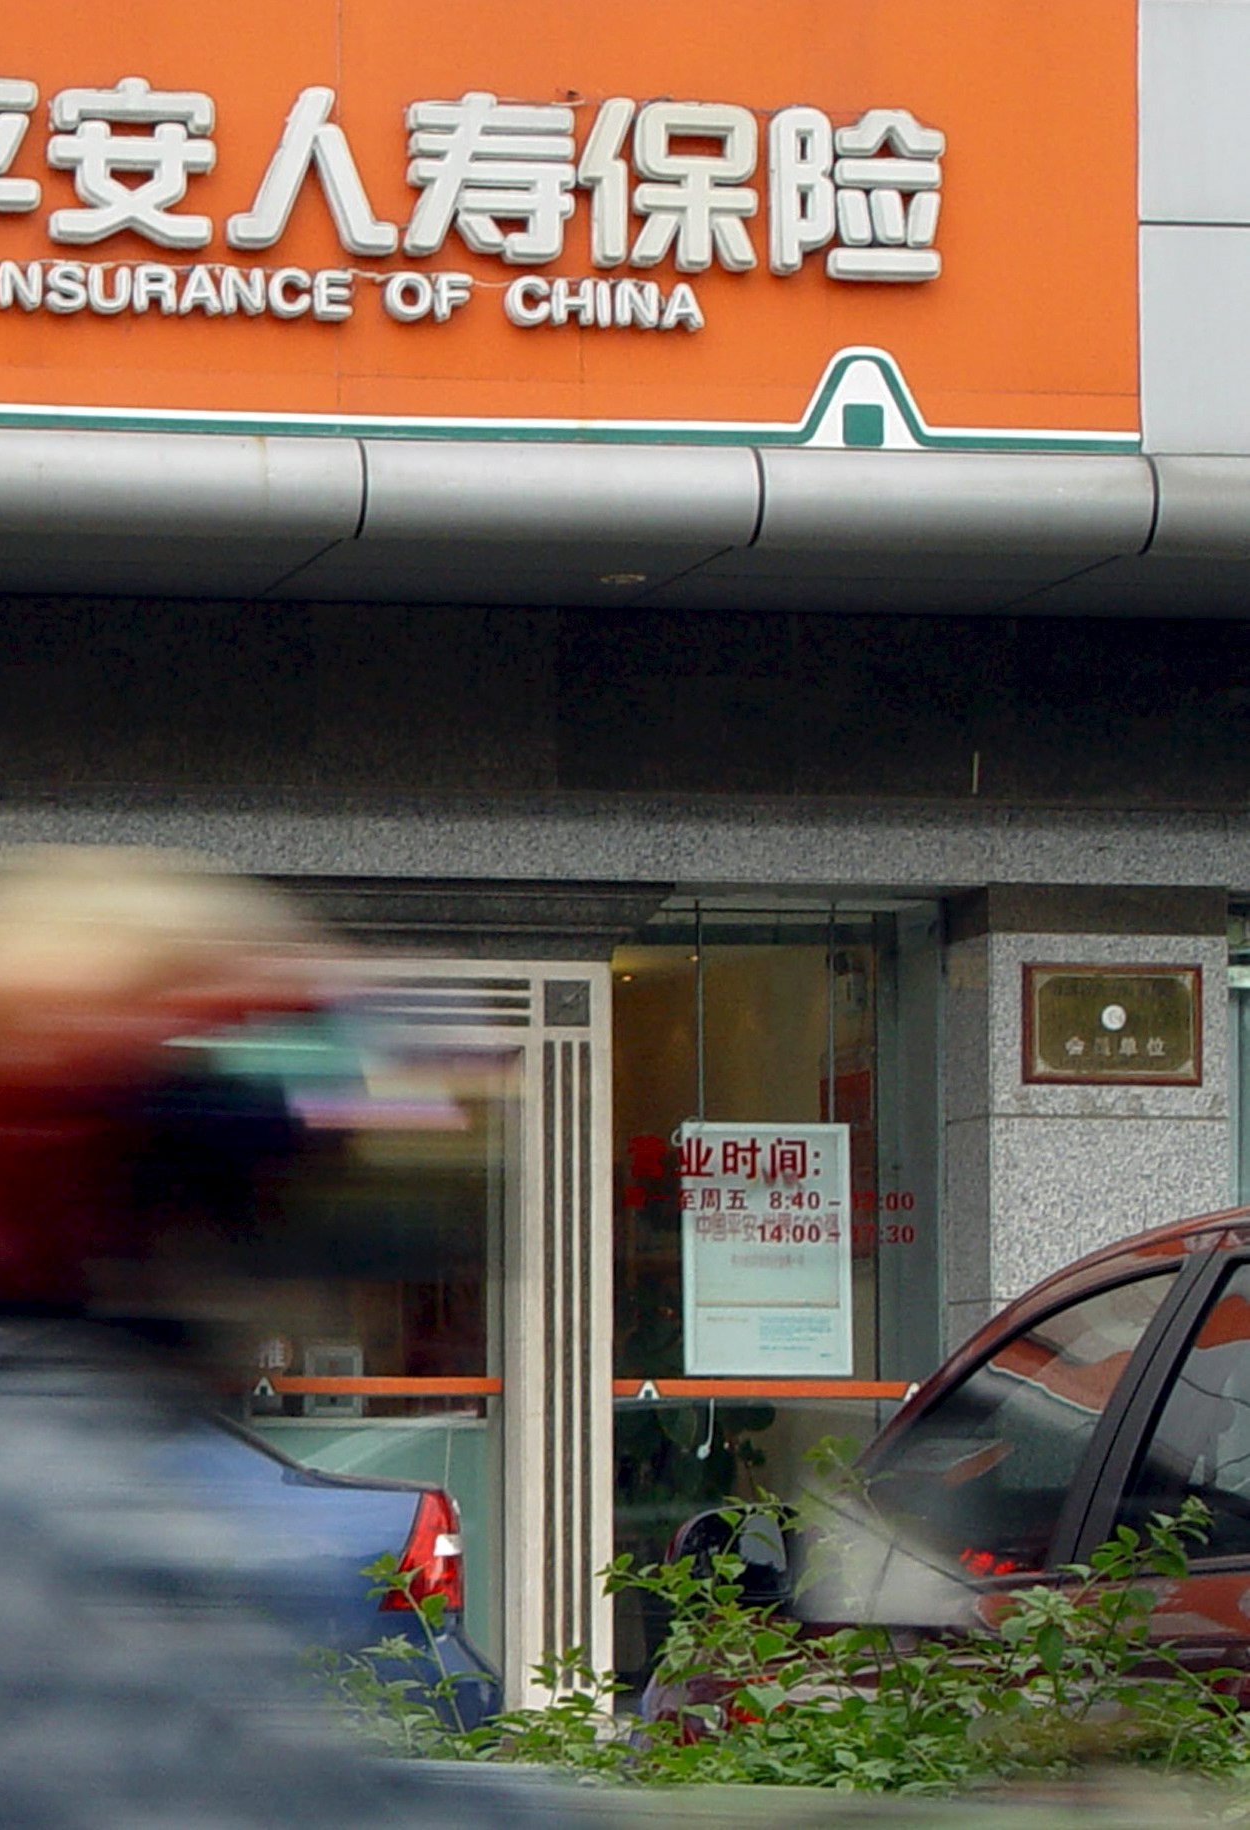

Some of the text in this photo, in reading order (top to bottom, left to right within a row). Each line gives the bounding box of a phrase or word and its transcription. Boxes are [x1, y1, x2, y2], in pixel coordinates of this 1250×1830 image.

[384, 270, 472, 324] OF
[503, 274, 705, 331] CHINA
[769, 1190, 821, 1210] 8:40
[756, 1224, 821, 1244] 14:00
